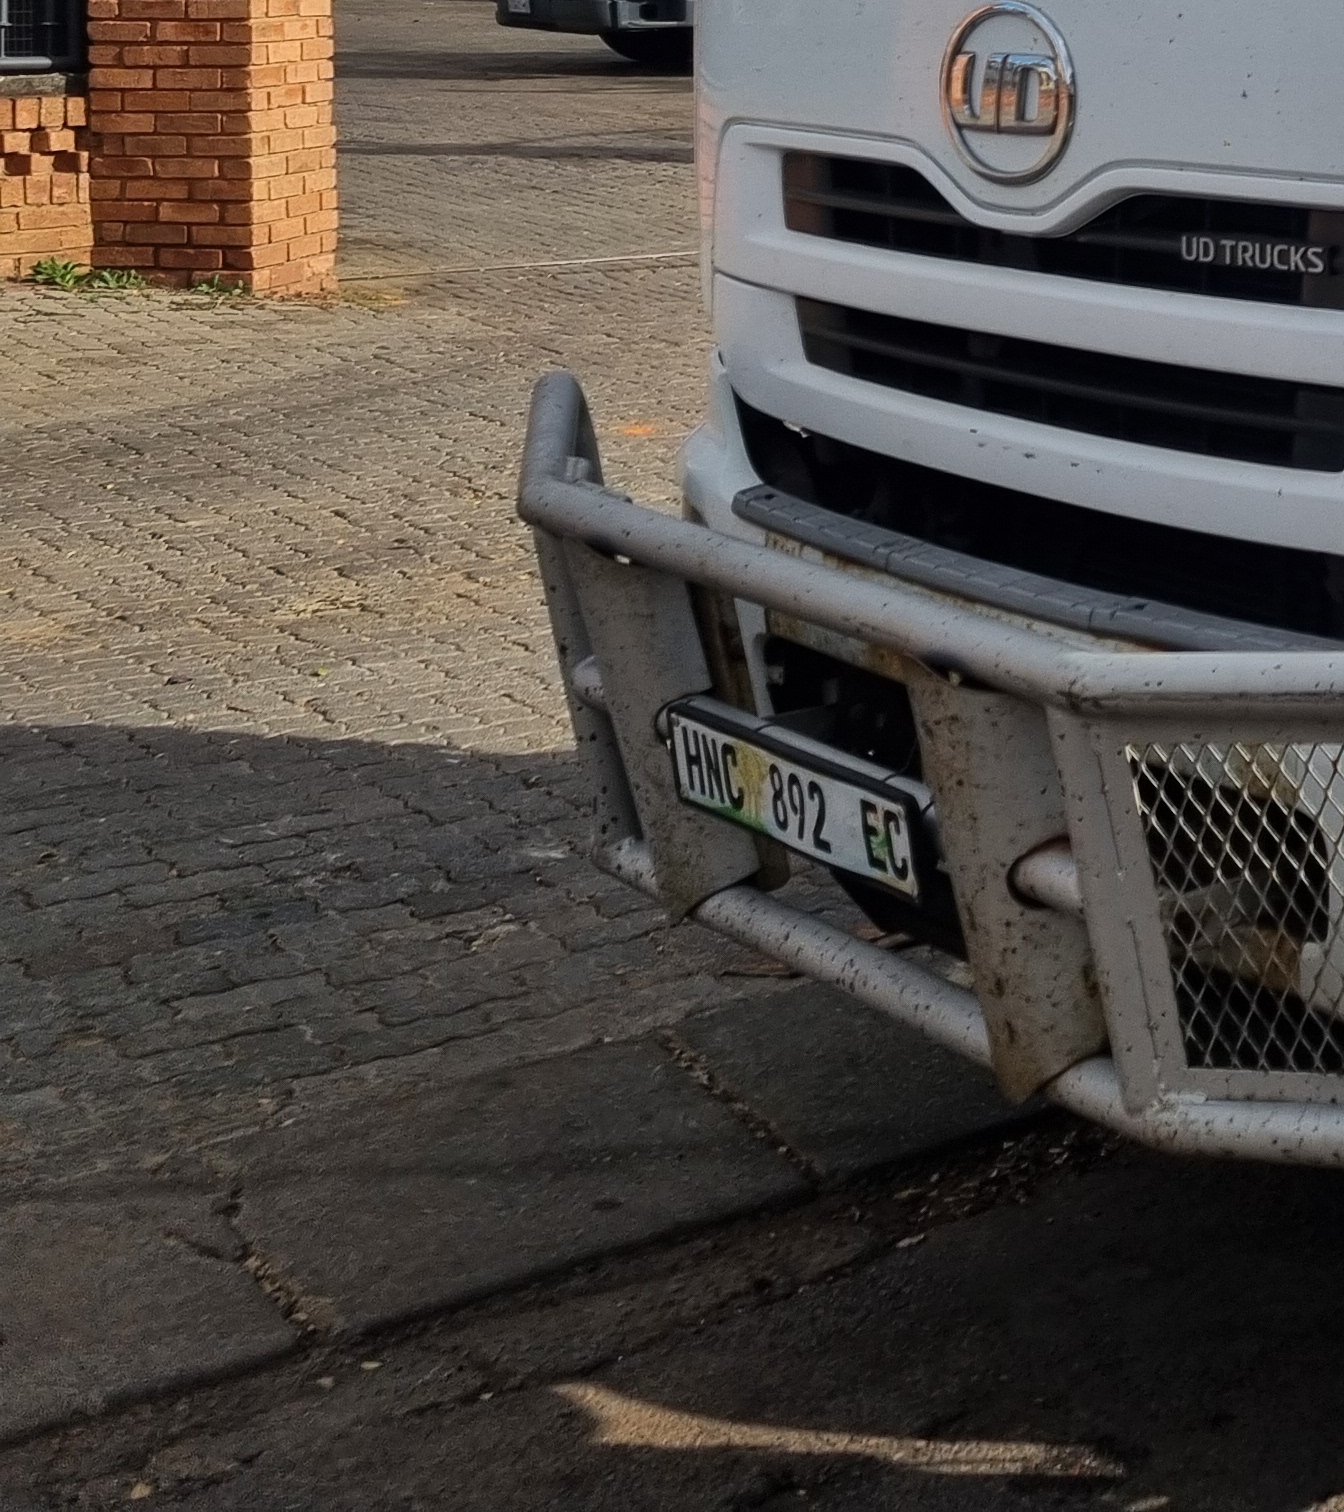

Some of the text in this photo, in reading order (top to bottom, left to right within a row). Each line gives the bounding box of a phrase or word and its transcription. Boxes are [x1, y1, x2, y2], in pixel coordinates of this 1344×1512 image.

[949, 50, 1058, 136] UD
[1180, 233, 1326, 275] UD TRUCKS
[682, 725, 909, 881] HNC 892 EC
